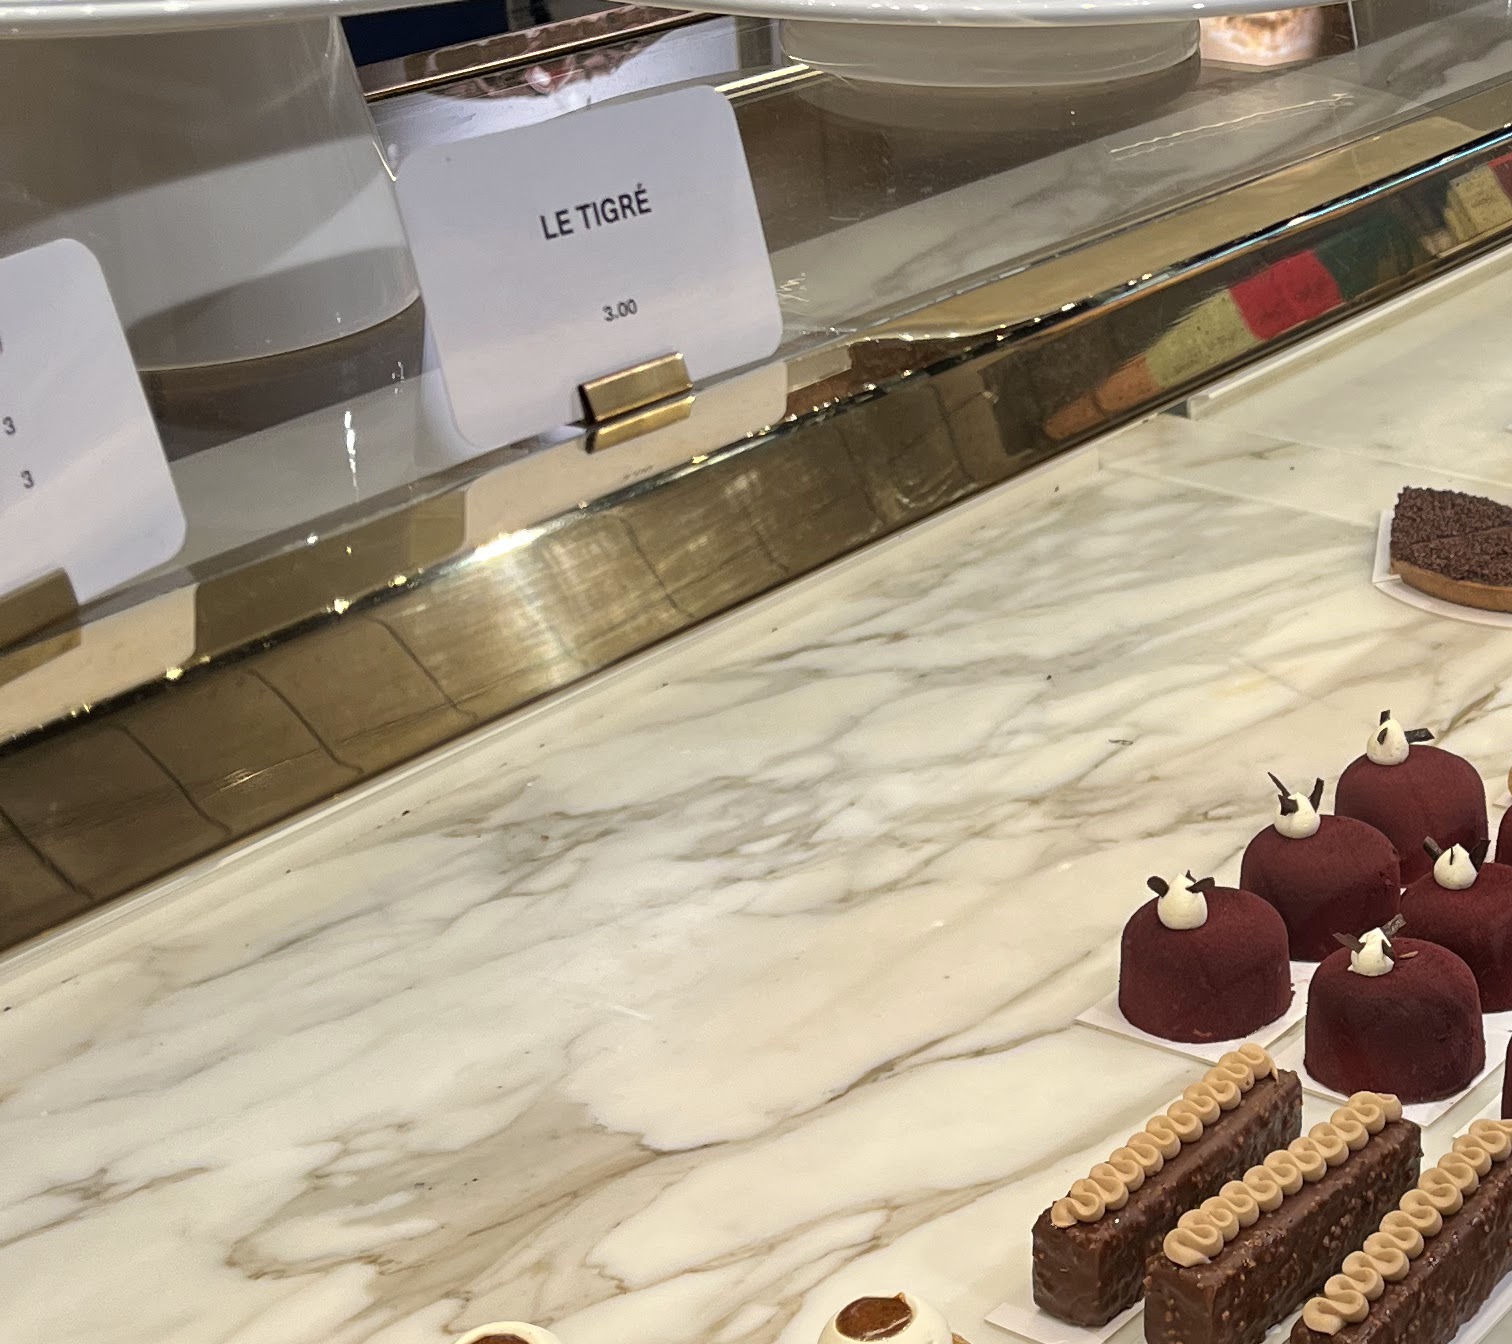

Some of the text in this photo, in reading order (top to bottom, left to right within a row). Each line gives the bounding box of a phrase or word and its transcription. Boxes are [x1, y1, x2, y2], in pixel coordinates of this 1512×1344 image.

[539, 182, 652, 240] LE TIGRÉ
[602, 298, 638, 322] 3.00
[2, 416, 16, 435] 3
[21, 470, 34, 489] 3
